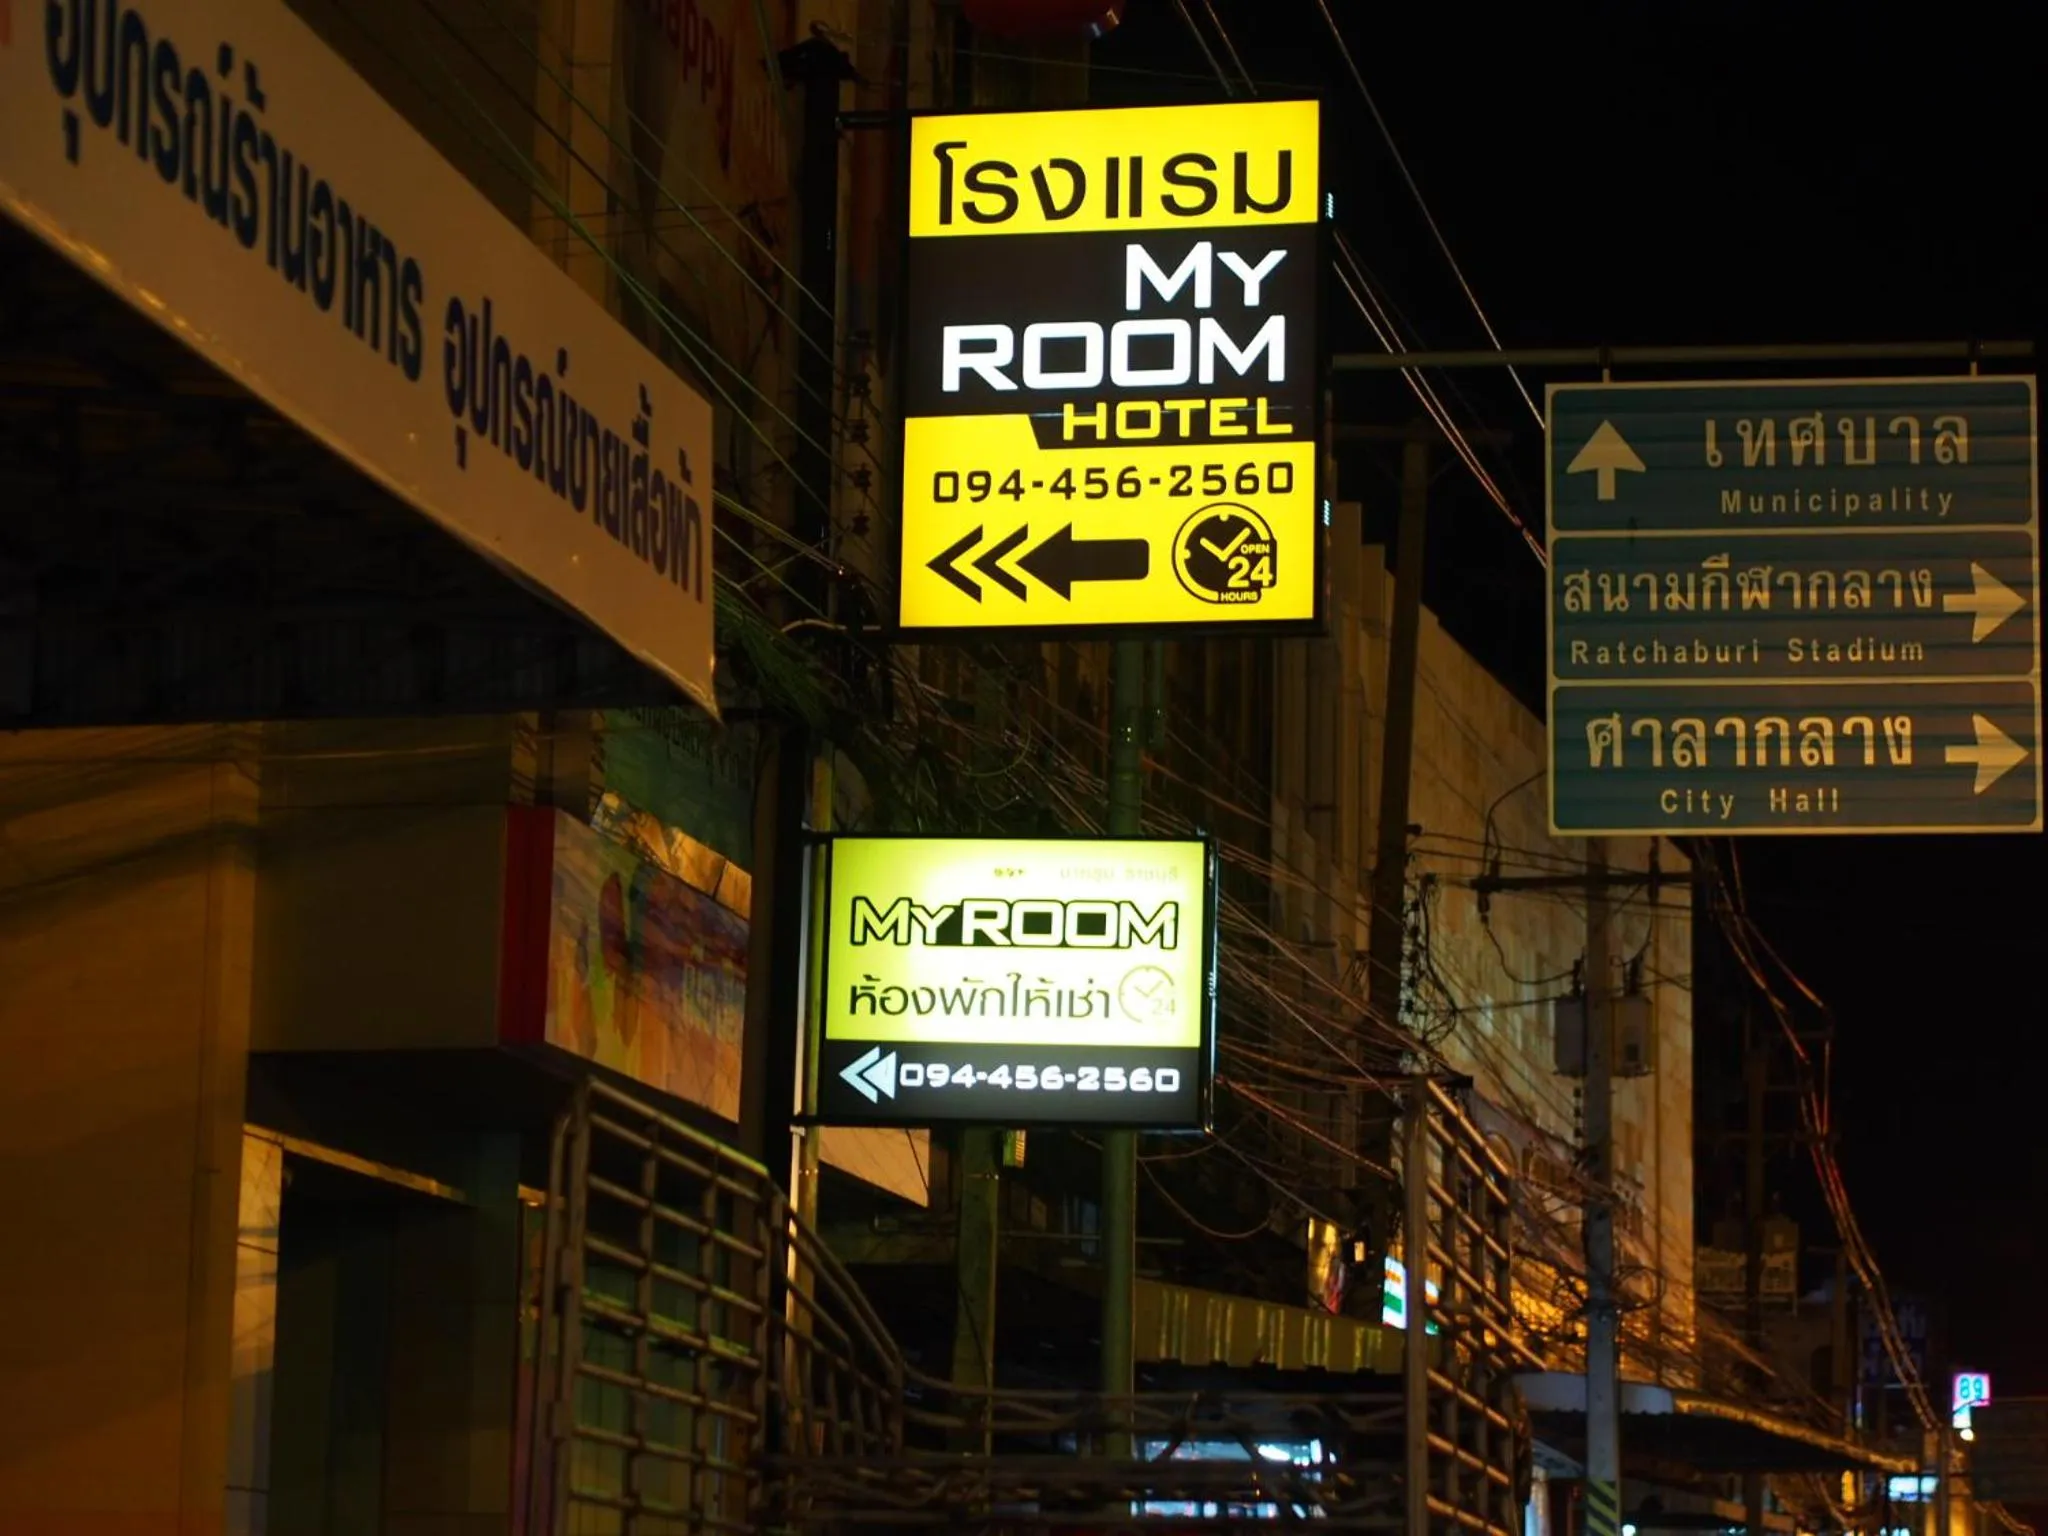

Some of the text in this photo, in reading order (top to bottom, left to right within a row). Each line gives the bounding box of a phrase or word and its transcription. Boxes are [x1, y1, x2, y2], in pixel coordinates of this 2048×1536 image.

[933, 141, 1292, 226] โรงแรม
[1125, 241, 1288, 311] MY
[942, 315, 1286, 392] ROOM
[1062, 397, 1294, 442] HOTEL
[1704, 410, 1969, 468] เทศบาล
[933, 461, 1294, 506] 094-456-2560
[1721, 489, 1954, 517] Municipality
[1226, 555, 1274, 588] 24
[1239, 546, 1271, 556] OPEN
[1219, 590, 1259, 603] HOURS
[1563, 552, 1934, 613] สนามกีฬากลาง
[1571, 637, 1924, 665] Ratchaburi Stadium
[1586, 712, 1913, 768] ศาลากลาง
[1660, 787, 1839, 820] City Hall
[849, 972, 1111, 1019] ห้องพักให้เช่า
[899, 1062, 1181, 1093] 094-456-2560
